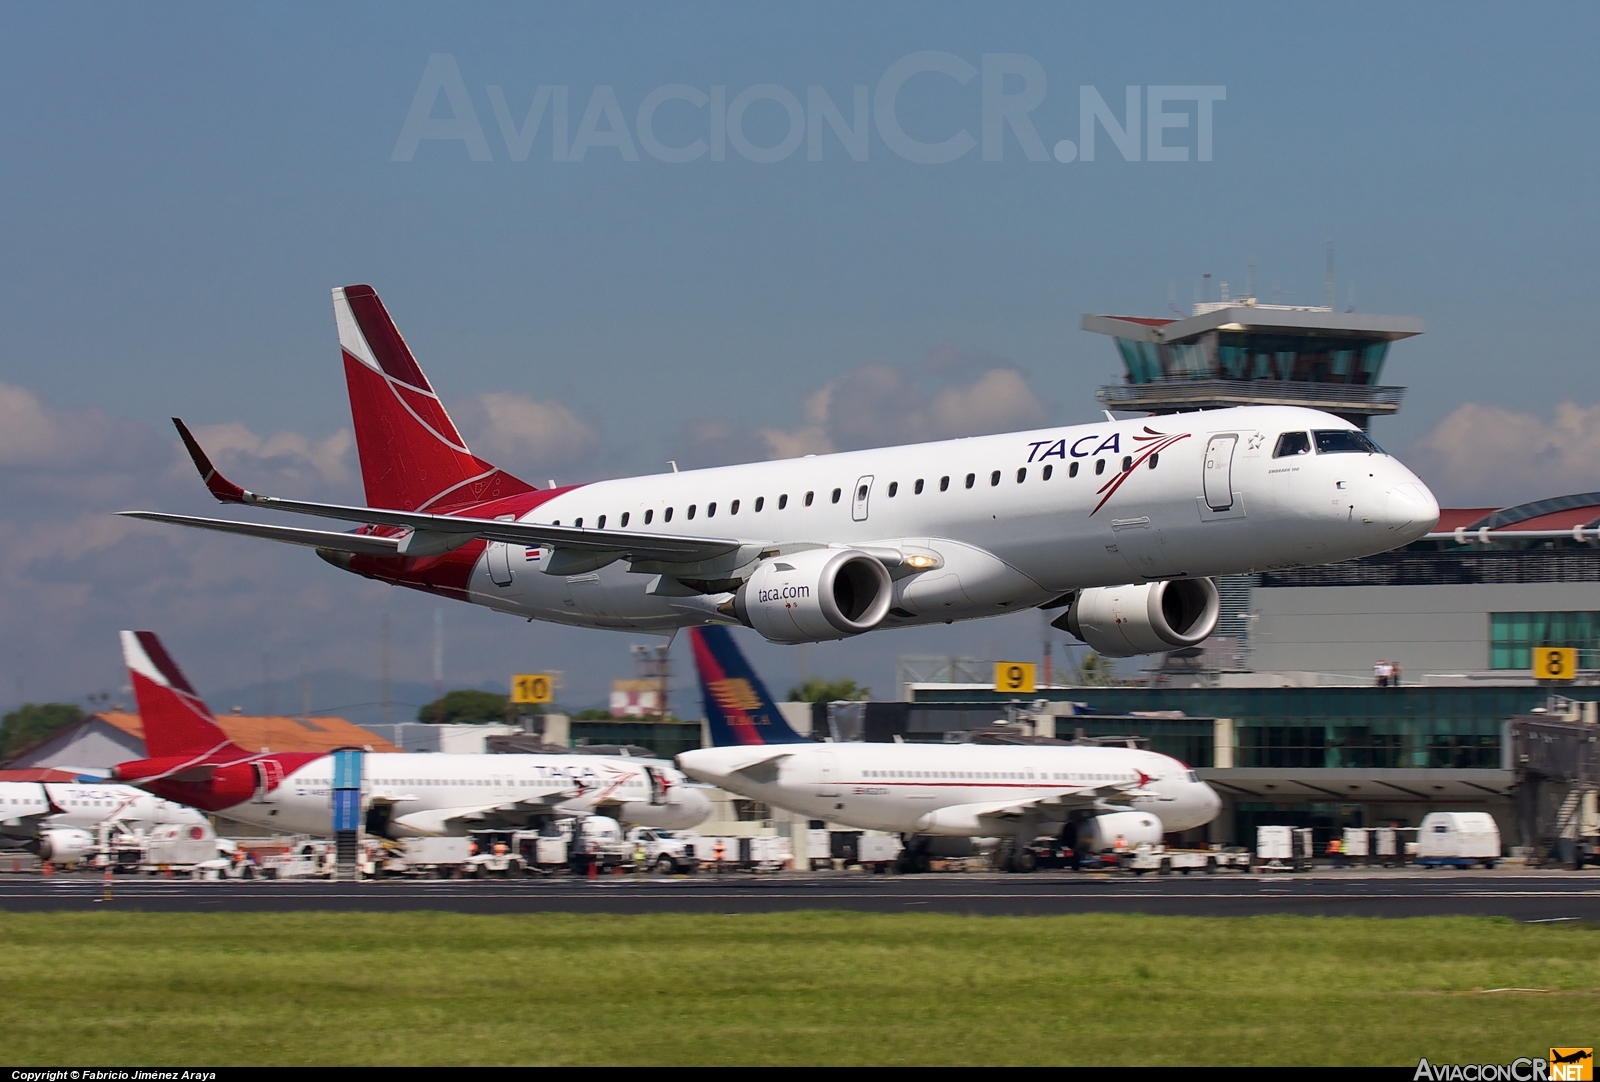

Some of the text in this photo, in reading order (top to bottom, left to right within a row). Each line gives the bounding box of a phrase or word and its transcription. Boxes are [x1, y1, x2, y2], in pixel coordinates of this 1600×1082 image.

[1027, 432, 1120, 463] TACA
[758, 585, 810, 603] taca.com
[1545, 651, 1565, 675] 8
[516, 677, 548, 699] 10
[1005, 666, 1024, 688] 9
[724, 715, 772, 726] TACA
[532, 765, 600, 779] TACA
